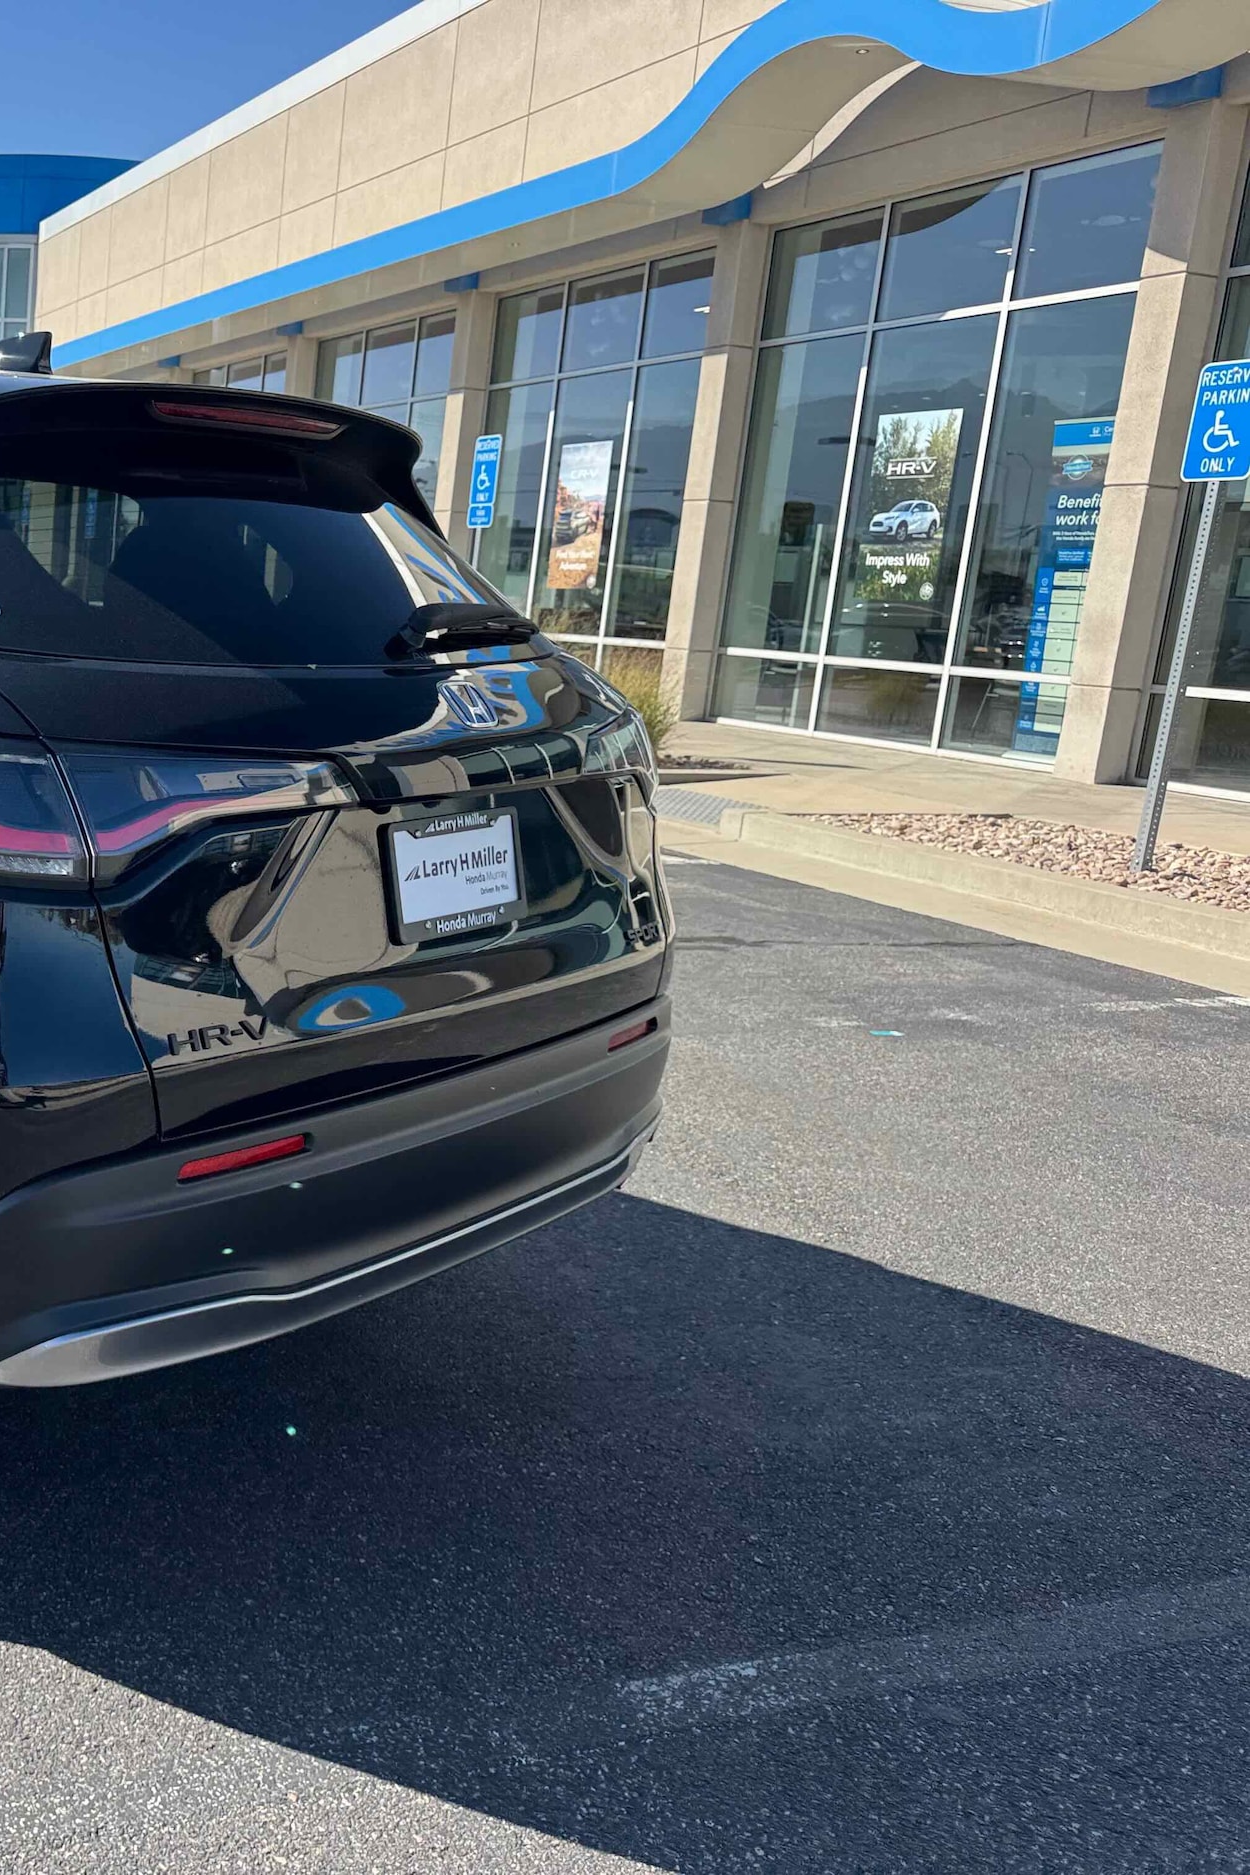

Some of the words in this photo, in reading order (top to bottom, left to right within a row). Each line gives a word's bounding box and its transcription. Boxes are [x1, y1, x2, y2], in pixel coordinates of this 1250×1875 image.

[886, 460, 937, 476] HR-V
[1199, 456, 1236, 473] ONLY
[1056, 510, 1089, 526] work
[865, 552, 904, 570] Impress
[905, 551, 930, 567] With
[882, 570, 908, 588] Style
[434, 819, 457, 832] Larry
[457, 817, 464, 828] H
[465, 812, 488, 827] Miller
[422, 858, 458, 877] Larry
[459, 852, 470, 871] H
[471, 845, 508, 869] Miller
[465, 872, 486, 885] Honda
[436, 914, 467, 934] Honda
[467, 911, 497, 927] Murray
[167, 1015, 268, 1056] HR-V
